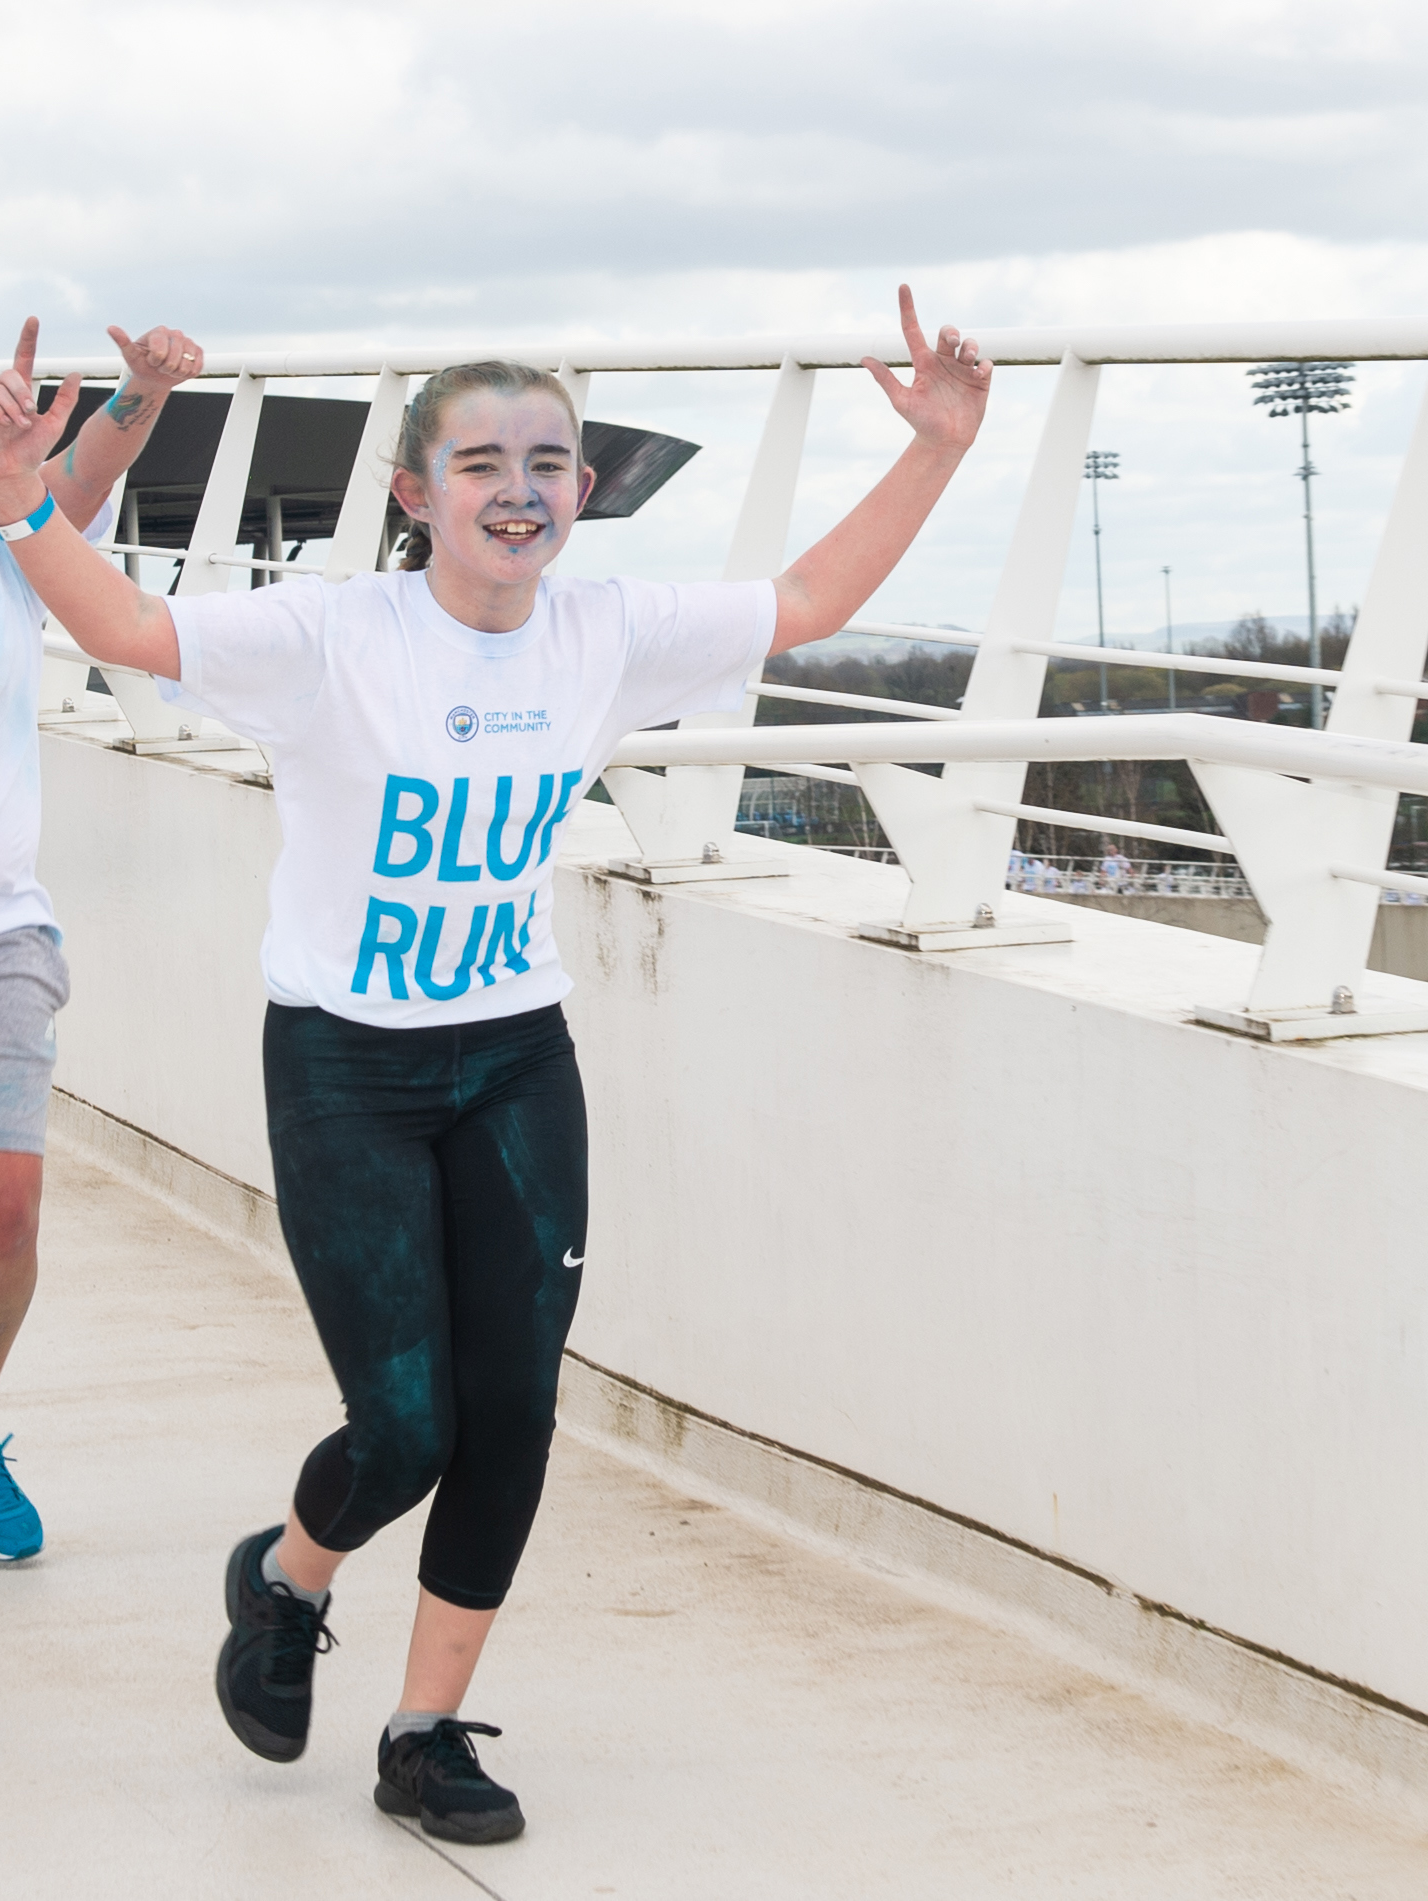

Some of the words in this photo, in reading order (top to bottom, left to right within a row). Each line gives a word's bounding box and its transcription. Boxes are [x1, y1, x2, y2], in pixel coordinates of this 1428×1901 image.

[484, 711, 509, 722] CITY
[511, 711, 523, 720] IN
[526, 710, 548, 720] THE
[484, 721, 551, 733] COMMUNITY
[350, 890, 537, 1001] RUN
